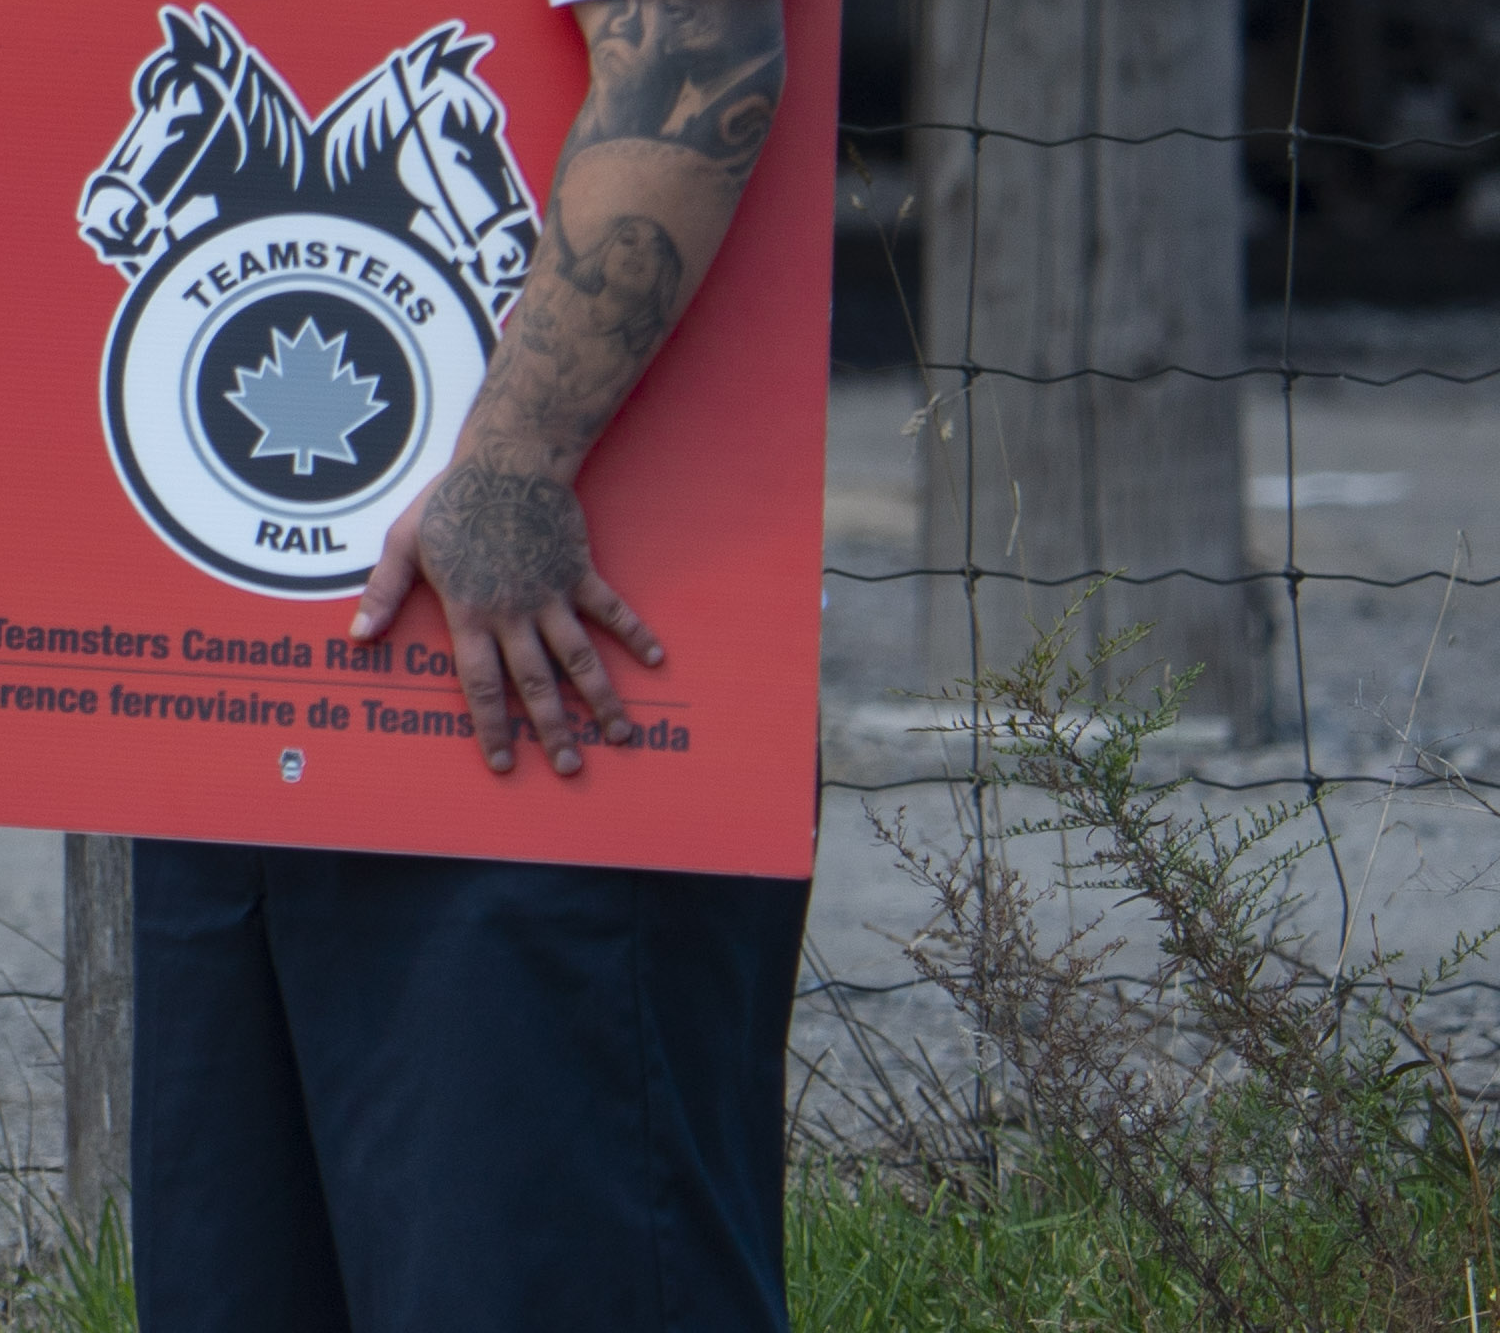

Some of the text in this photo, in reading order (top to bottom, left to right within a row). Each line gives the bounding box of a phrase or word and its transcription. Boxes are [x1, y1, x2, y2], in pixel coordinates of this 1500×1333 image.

[181, 242, 436, 327] TEAMSTERS
[255, 519, 347, 556] RAIL
[182, 629, 312, 668] Canada
[326, 638, 393, 673] Rail
[110, 684, 295, 727] ferroviaire
[307, 697, 349, 730] de
